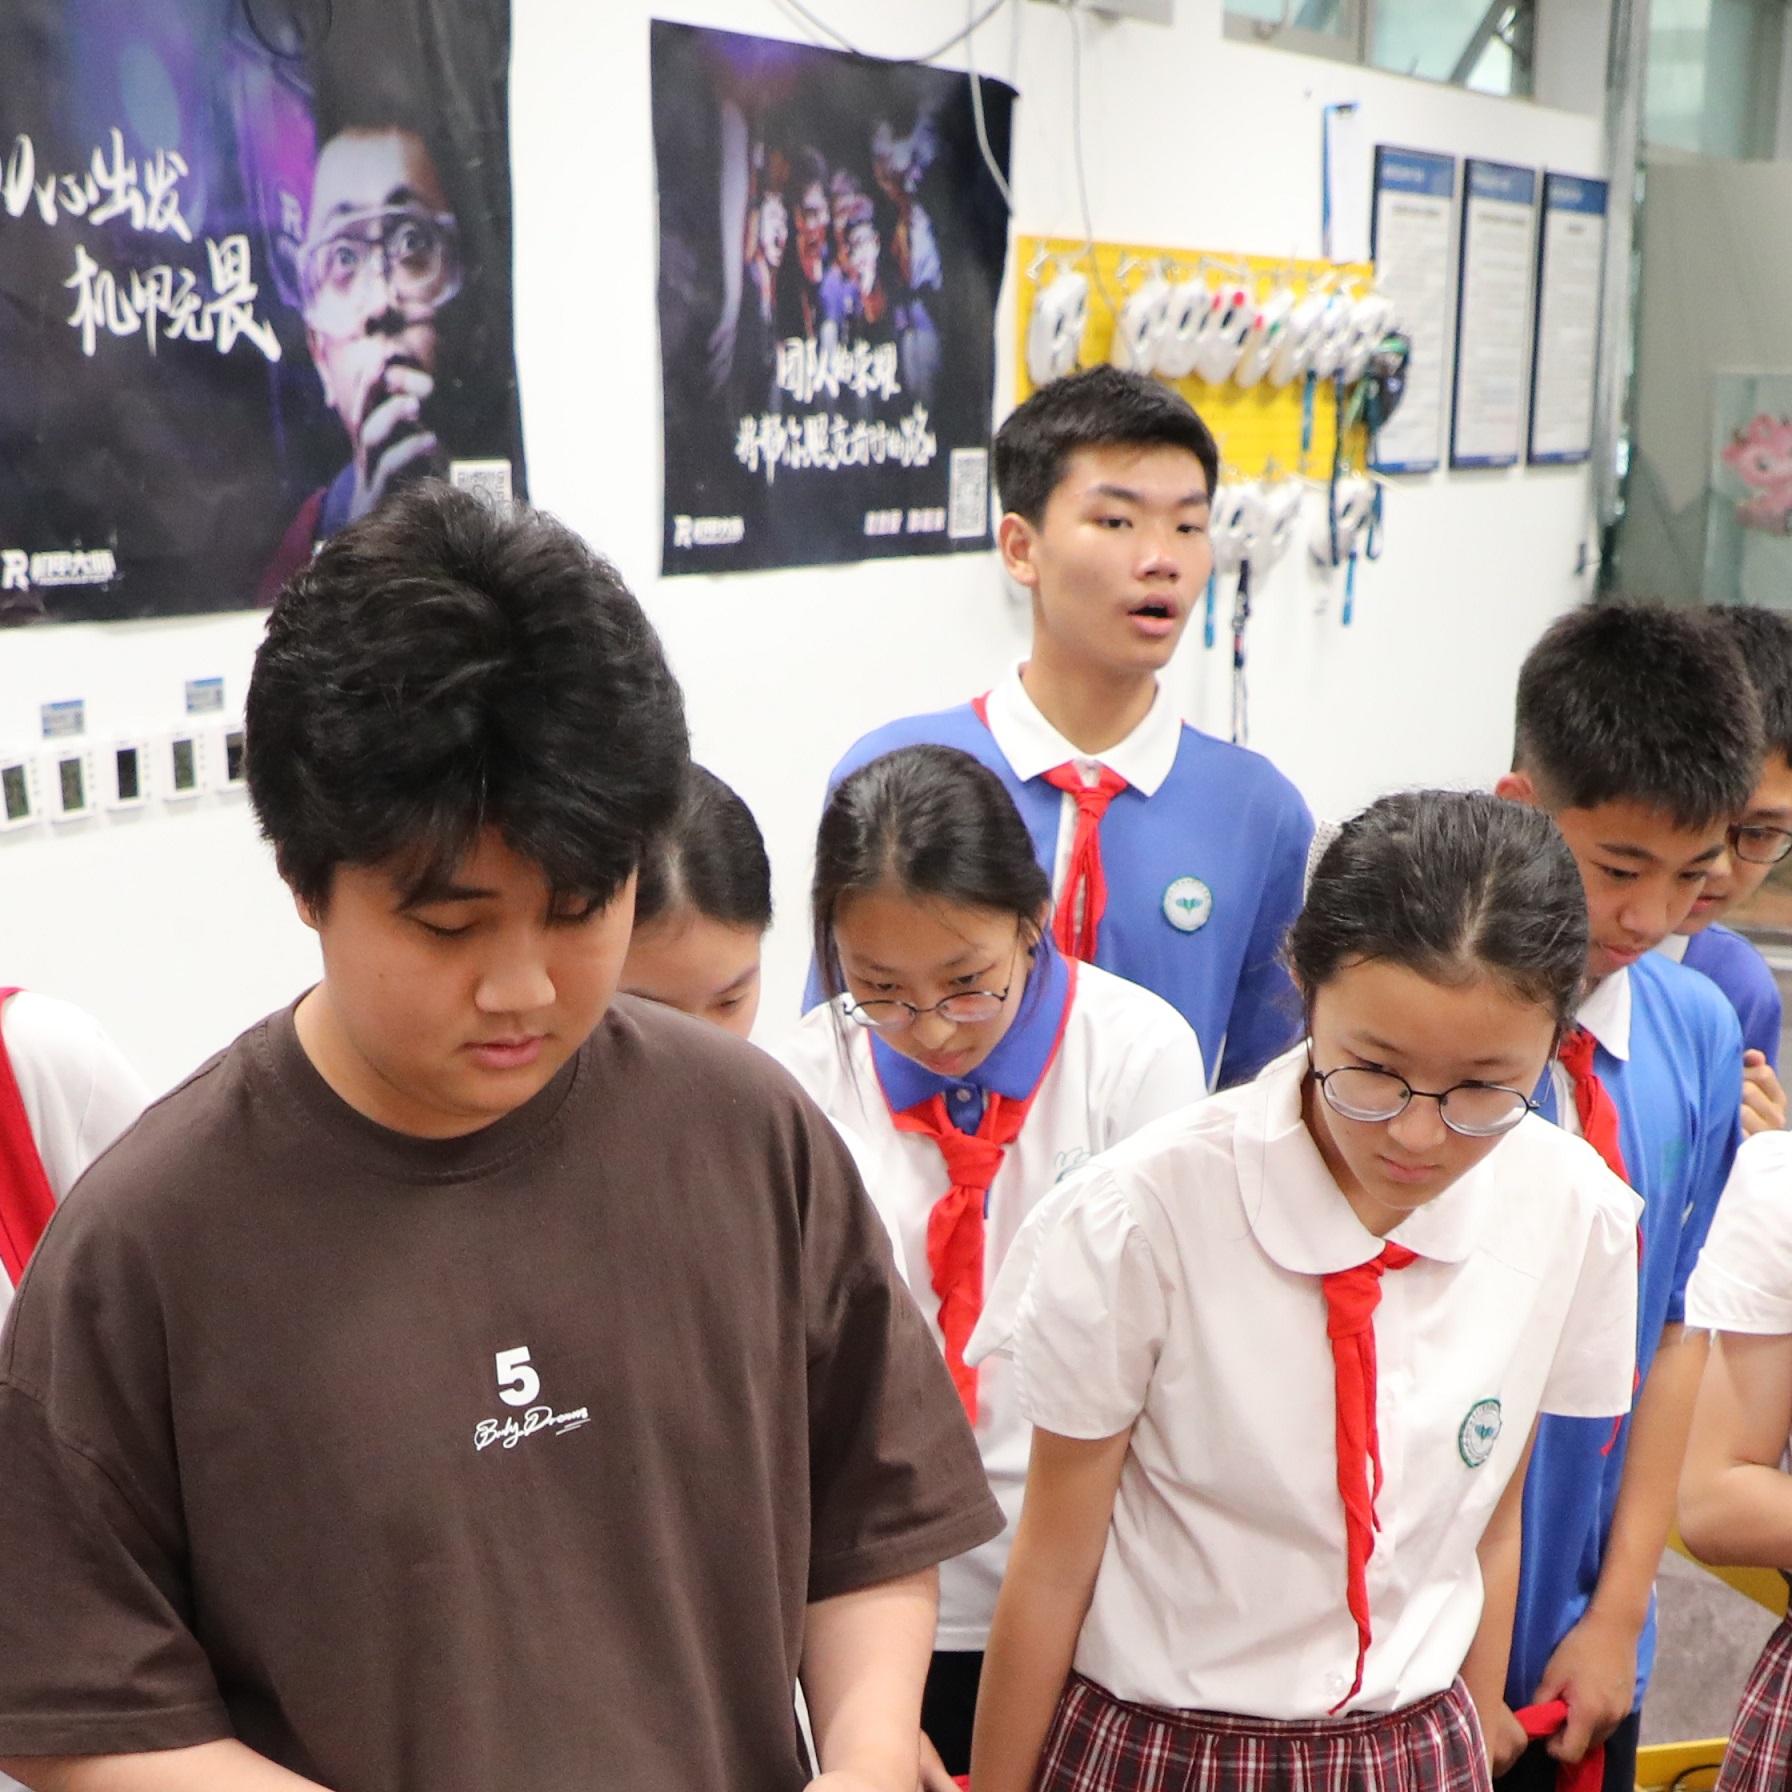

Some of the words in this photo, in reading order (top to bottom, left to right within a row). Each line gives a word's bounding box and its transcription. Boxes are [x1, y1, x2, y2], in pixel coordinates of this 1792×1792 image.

[64, 234, 282, 362] 机甲无畏
[496, 1346, 541, 1406] 5
